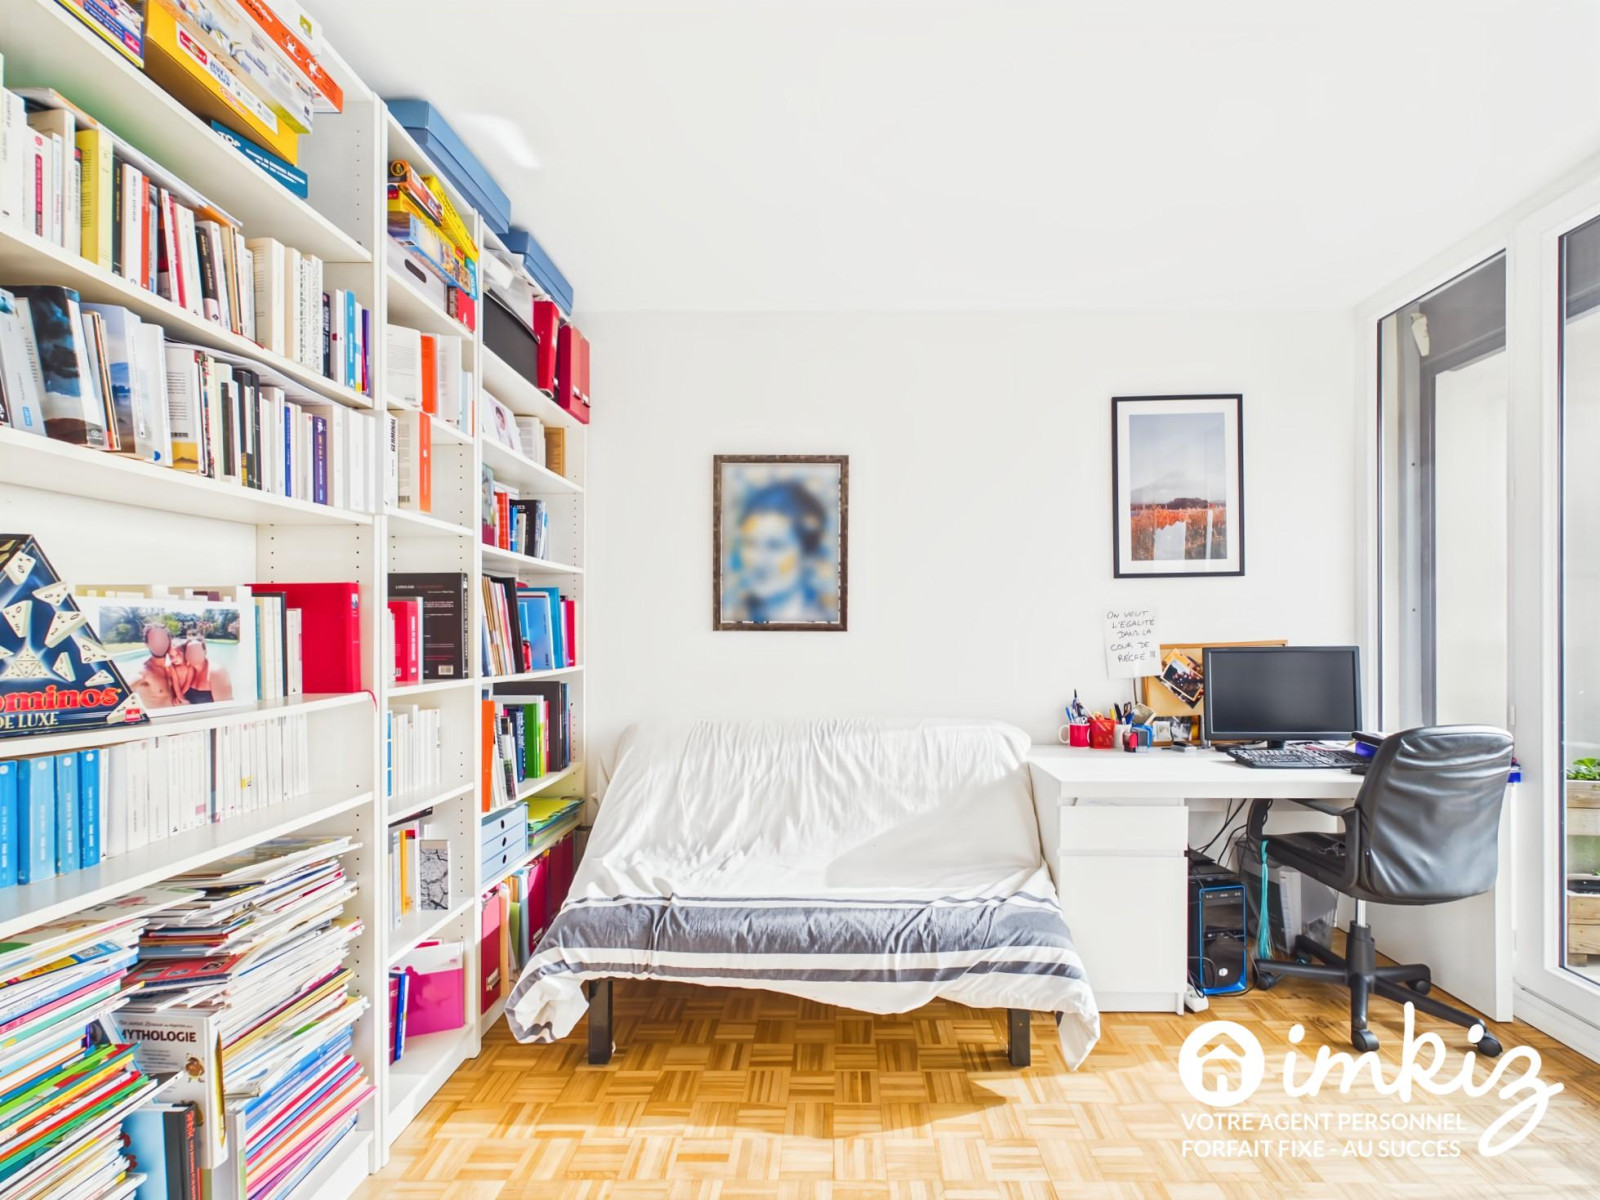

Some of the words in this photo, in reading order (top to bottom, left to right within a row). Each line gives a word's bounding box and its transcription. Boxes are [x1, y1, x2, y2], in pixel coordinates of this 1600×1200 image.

[1124, 610, 1149, 618] VEUT
[1111, 642, 1132, 651] COUR
[0, 684, 119, 713] minos
[18, 711, 60, 728] LUXE
